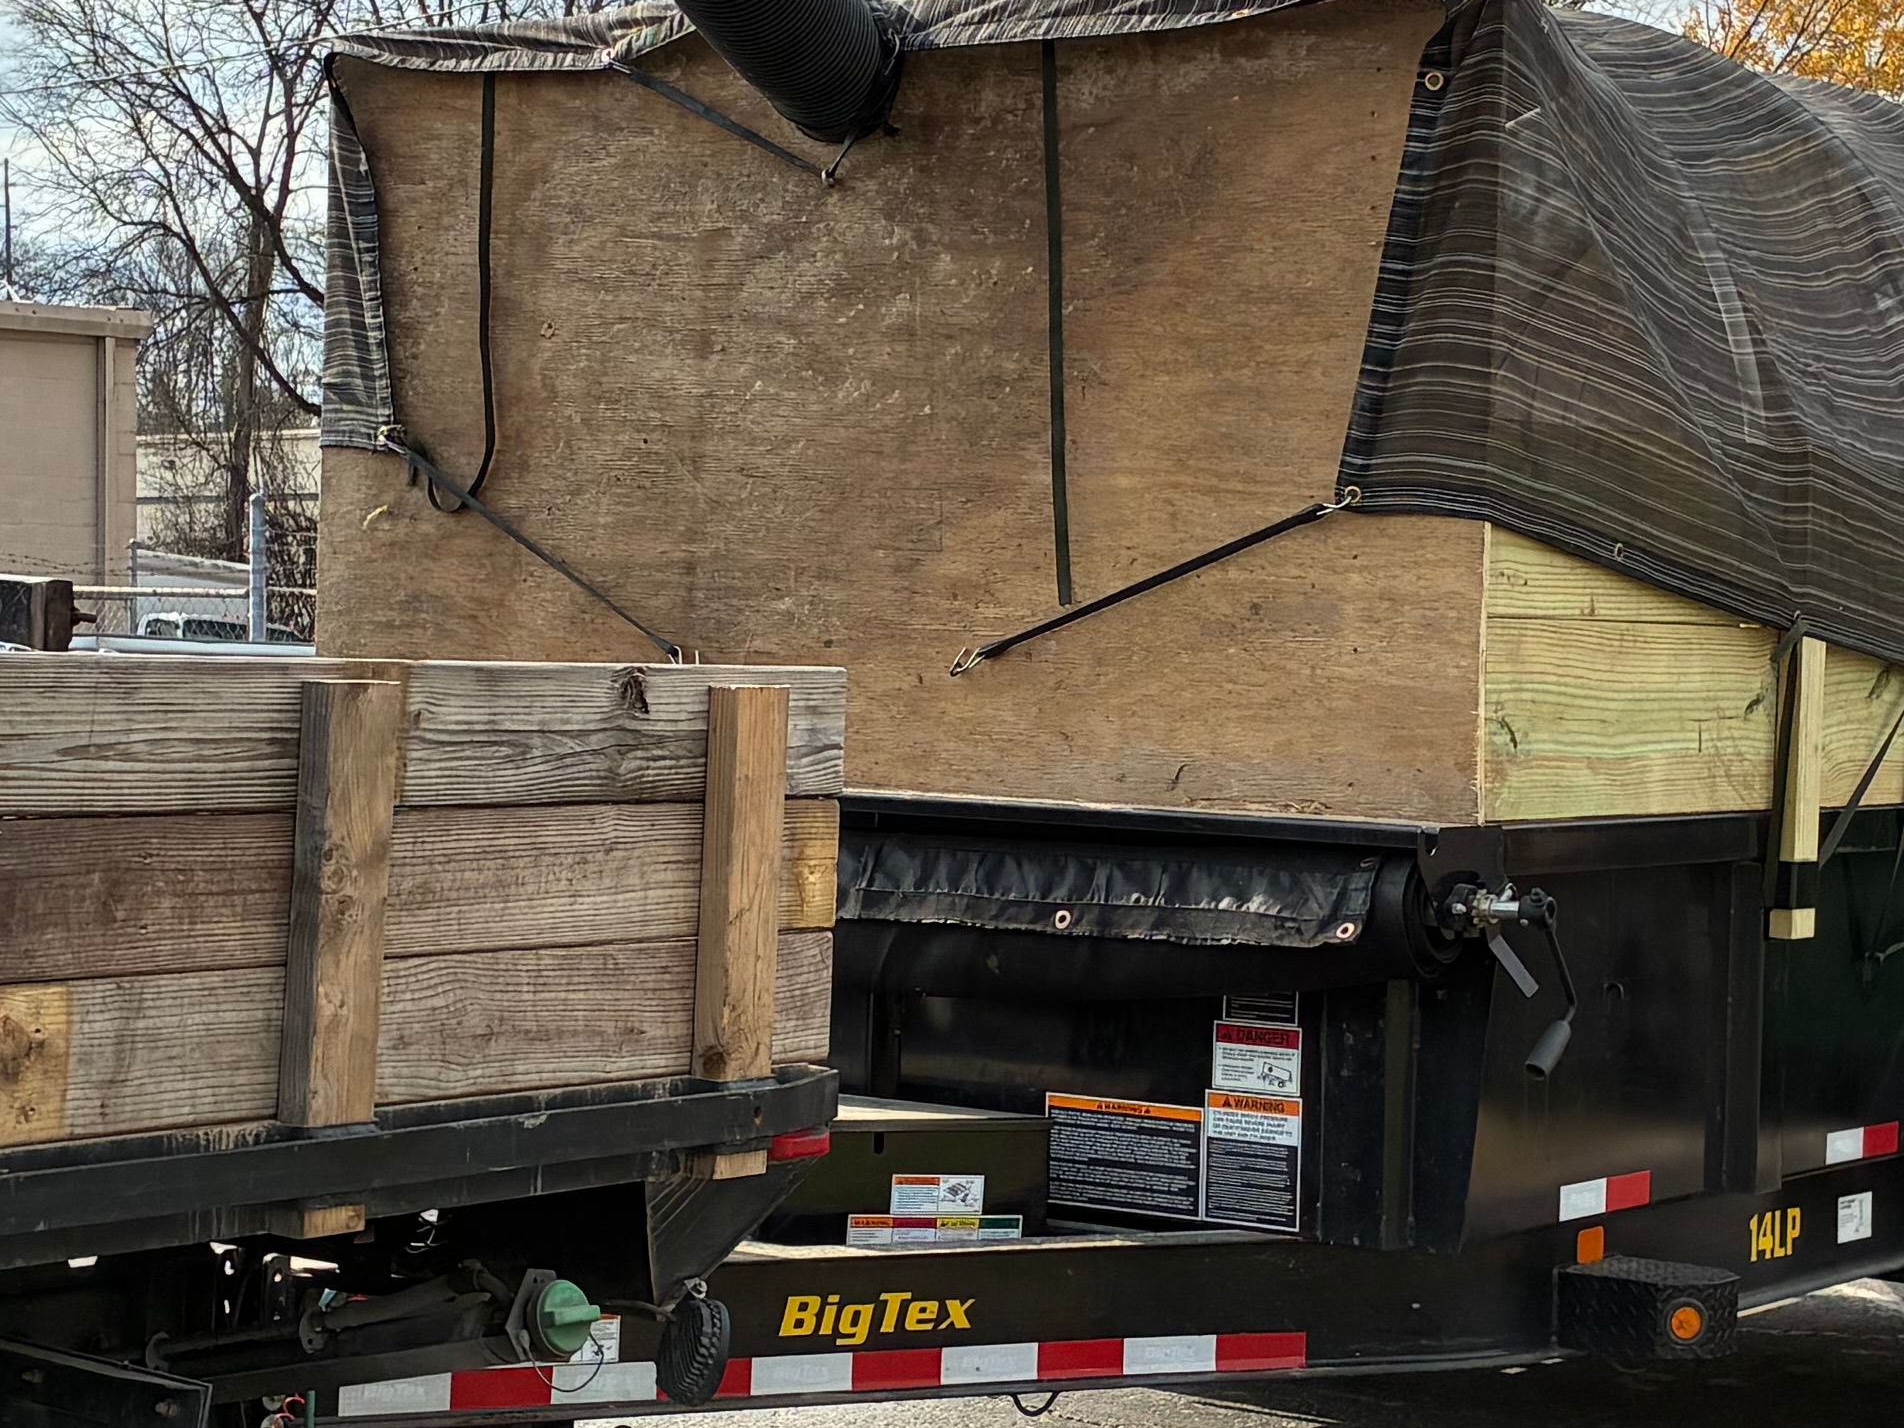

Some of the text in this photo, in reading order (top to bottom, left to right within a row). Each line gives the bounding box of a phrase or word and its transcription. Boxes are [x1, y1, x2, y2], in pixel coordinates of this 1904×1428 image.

[1238, 1028, 1289, 1045] DANGER
[1234, 1096, 1285, 1114] WARNING
[1749, 1207, 1801, 1262] 14LP
[779, 1292, 976, 1346] BigTex
